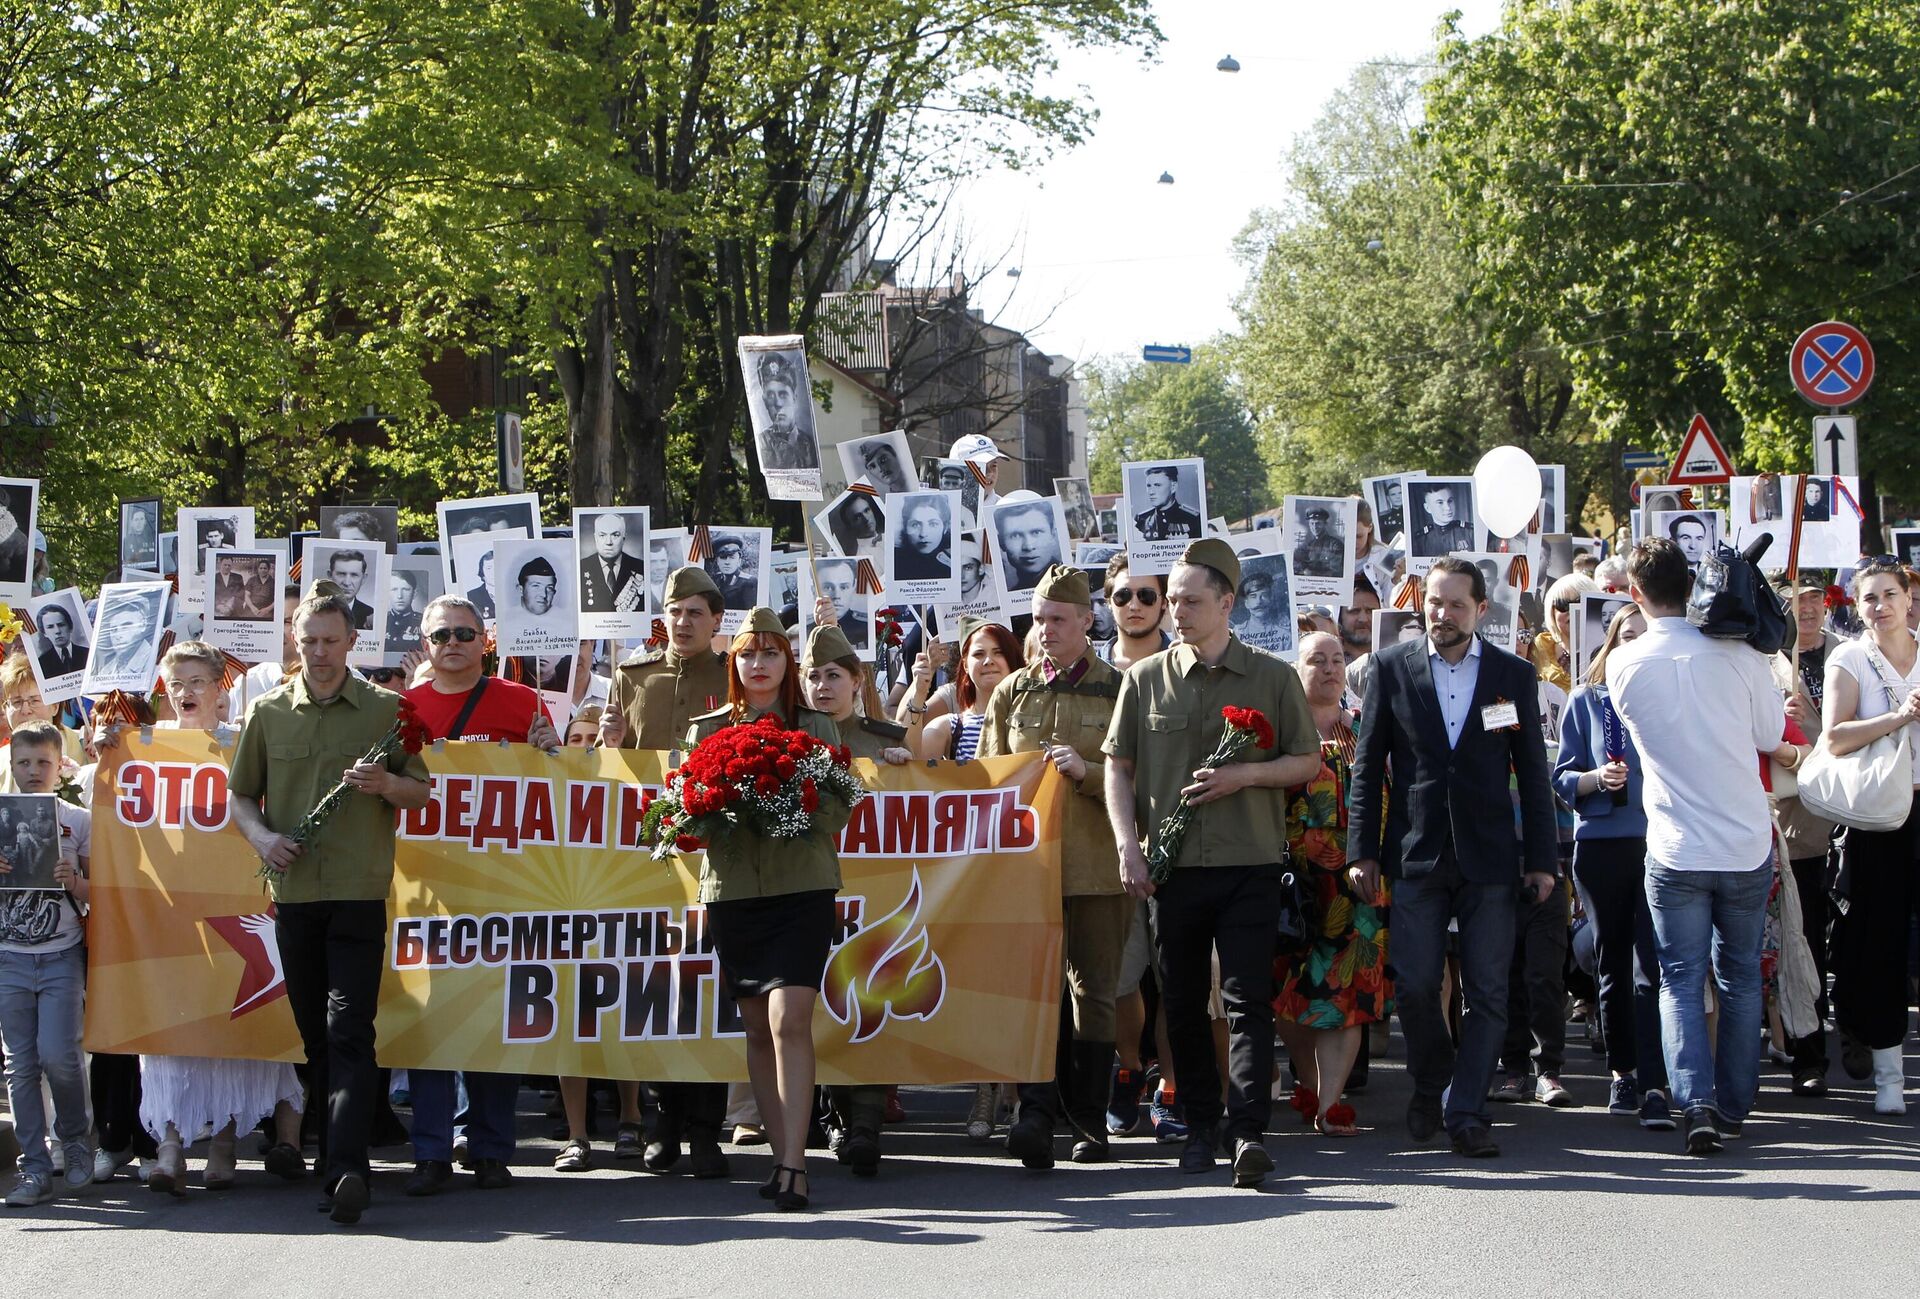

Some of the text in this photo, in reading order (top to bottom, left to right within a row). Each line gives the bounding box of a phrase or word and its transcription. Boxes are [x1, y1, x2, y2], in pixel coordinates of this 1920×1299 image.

[1132, 551, 1160, 559] Георгий
[44, 682, 73, 693] Александр
[1604, 707, 1612, 751] РОССИЯ
[118, 762, 231, 830] ЭТО
[394, 777, 557, 849] БЕДА
[569, 783, 603, 845] И
[832, 790, 1036, 854] АМЯТЬ
[507, 962, 555, 1040] В
